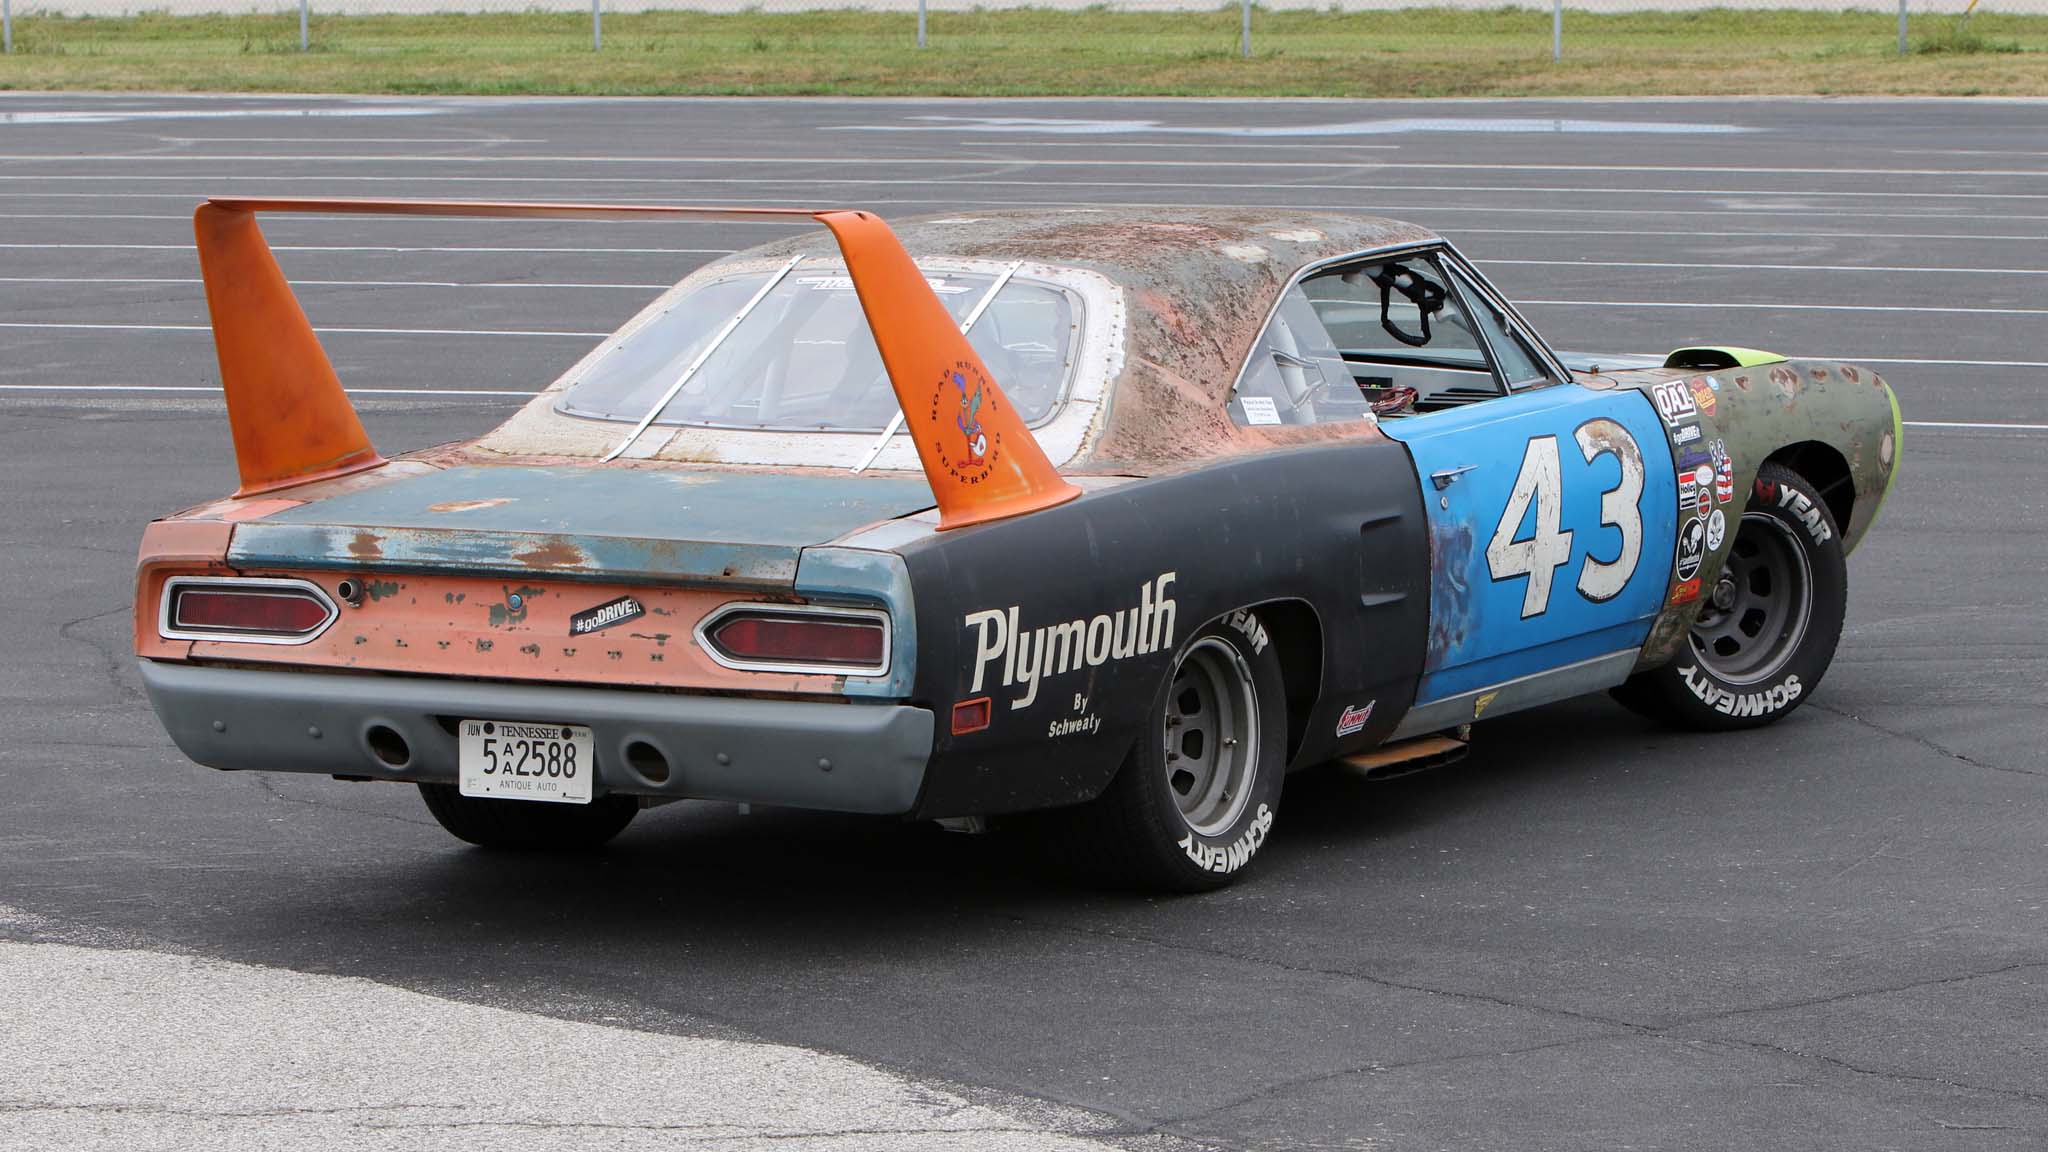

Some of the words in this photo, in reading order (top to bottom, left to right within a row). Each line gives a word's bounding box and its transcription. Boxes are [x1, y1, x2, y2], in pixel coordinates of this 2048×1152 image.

[1655, 383, 1694, 421] QA1
[935, 432, 1001, 485] SUPERBIRD
[1485, 416, 1646, 621] 43
[1778, 483, 1832, 546] YEAR
[576, 599, 641, 632] #goDRIVEit
[965, 571, 1176, 711] Plymouth
[1073, 692, 1089, 715] By
[1677, 664, 1802, 717] SCHWEATY
[467, 723, 481, 737] JUN
[499, 725, 560, 740] TENNESSEE
[1048, 712, 1102, 738] Schweaty
[500, 780, 532, 791] ANTIQUE
[536, 782, 557, 792] AUTO
[1177, 803, 1273, 874] SCHWEATY
